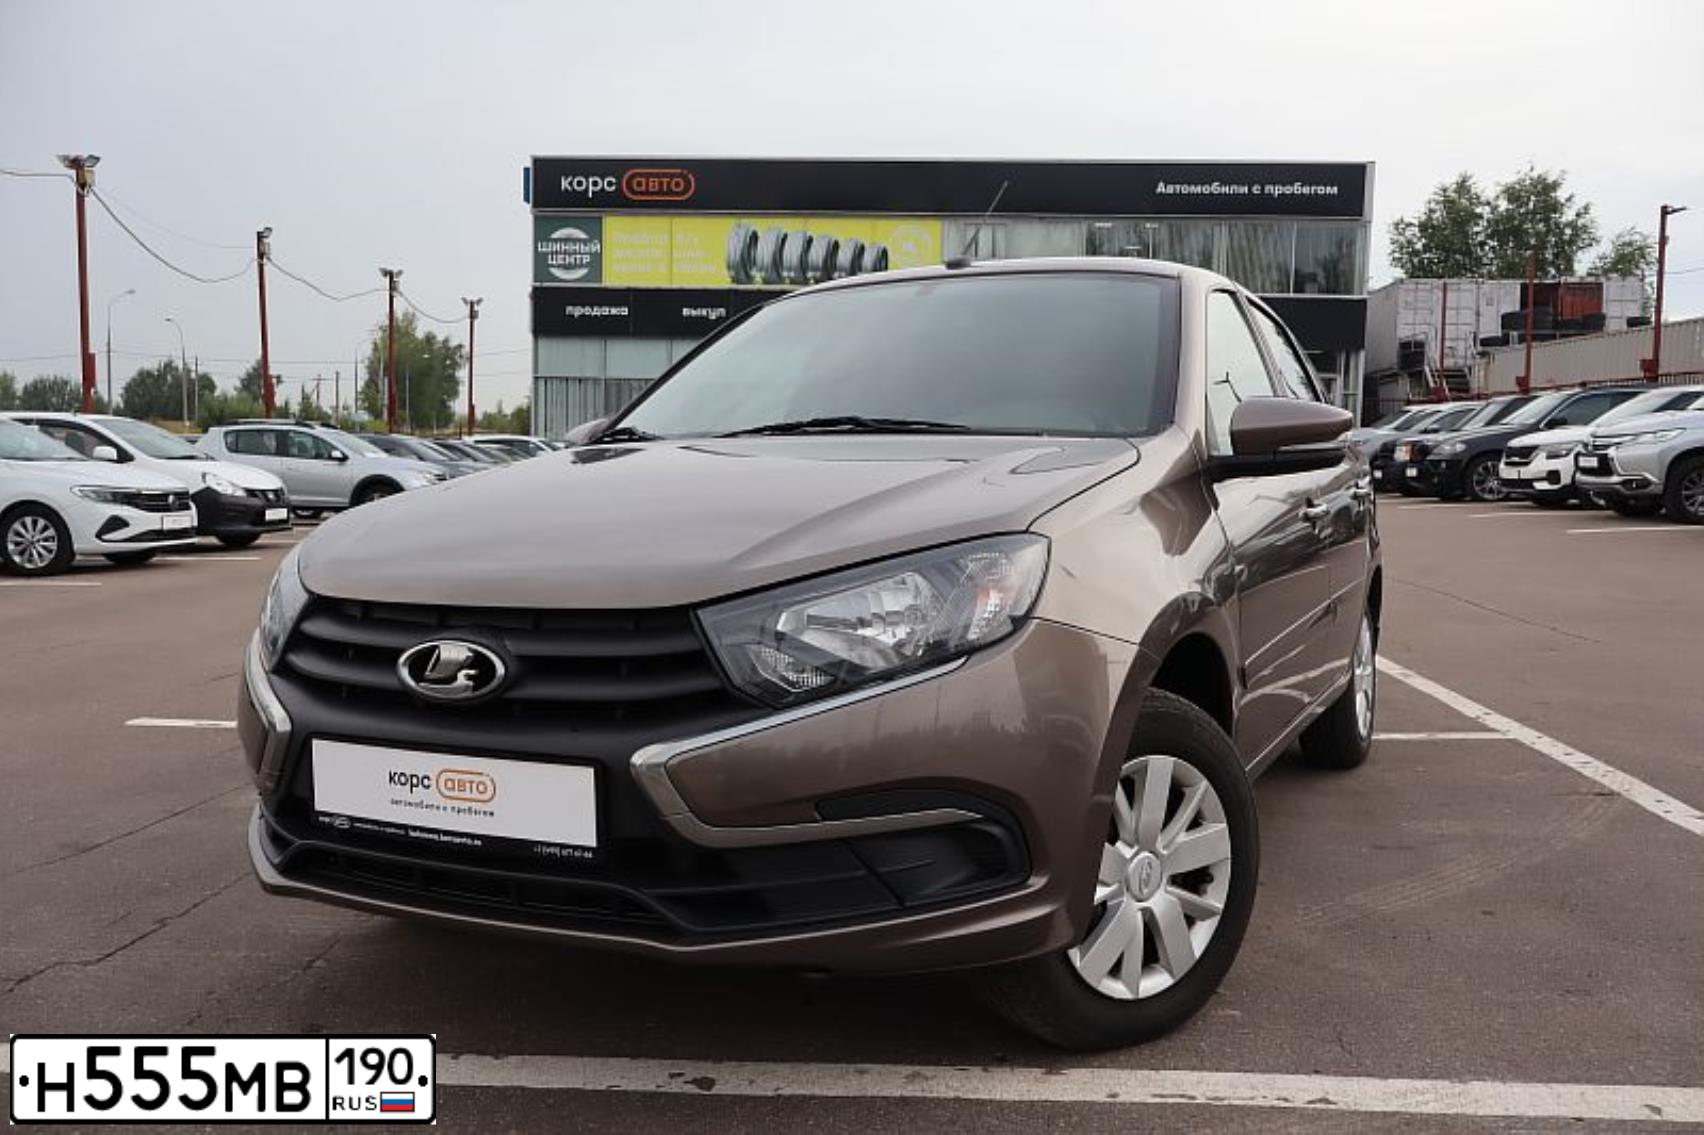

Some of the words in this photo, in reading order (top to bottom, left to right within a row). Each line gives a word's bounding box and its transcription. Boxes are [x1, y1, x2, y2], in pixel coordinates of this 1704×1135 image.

[561, 175, 616, 198] корс
[632, 177, 685, 192] авто
[1155, 181, 1249, 195] Автомобили
[1251, 184, 1262, 195] с
[1264, 181, 1338, 198] пробегом
[537, 239, 601, 253] ШИННЫЙ
[548, 254, 591, 265] ЦЕНТР
[565, 306, 629, 318] продажа
[682, 307, 727, 320] выкуп
[388, 769, 431, 794] корс
[444, 778, 488, 794] авто
